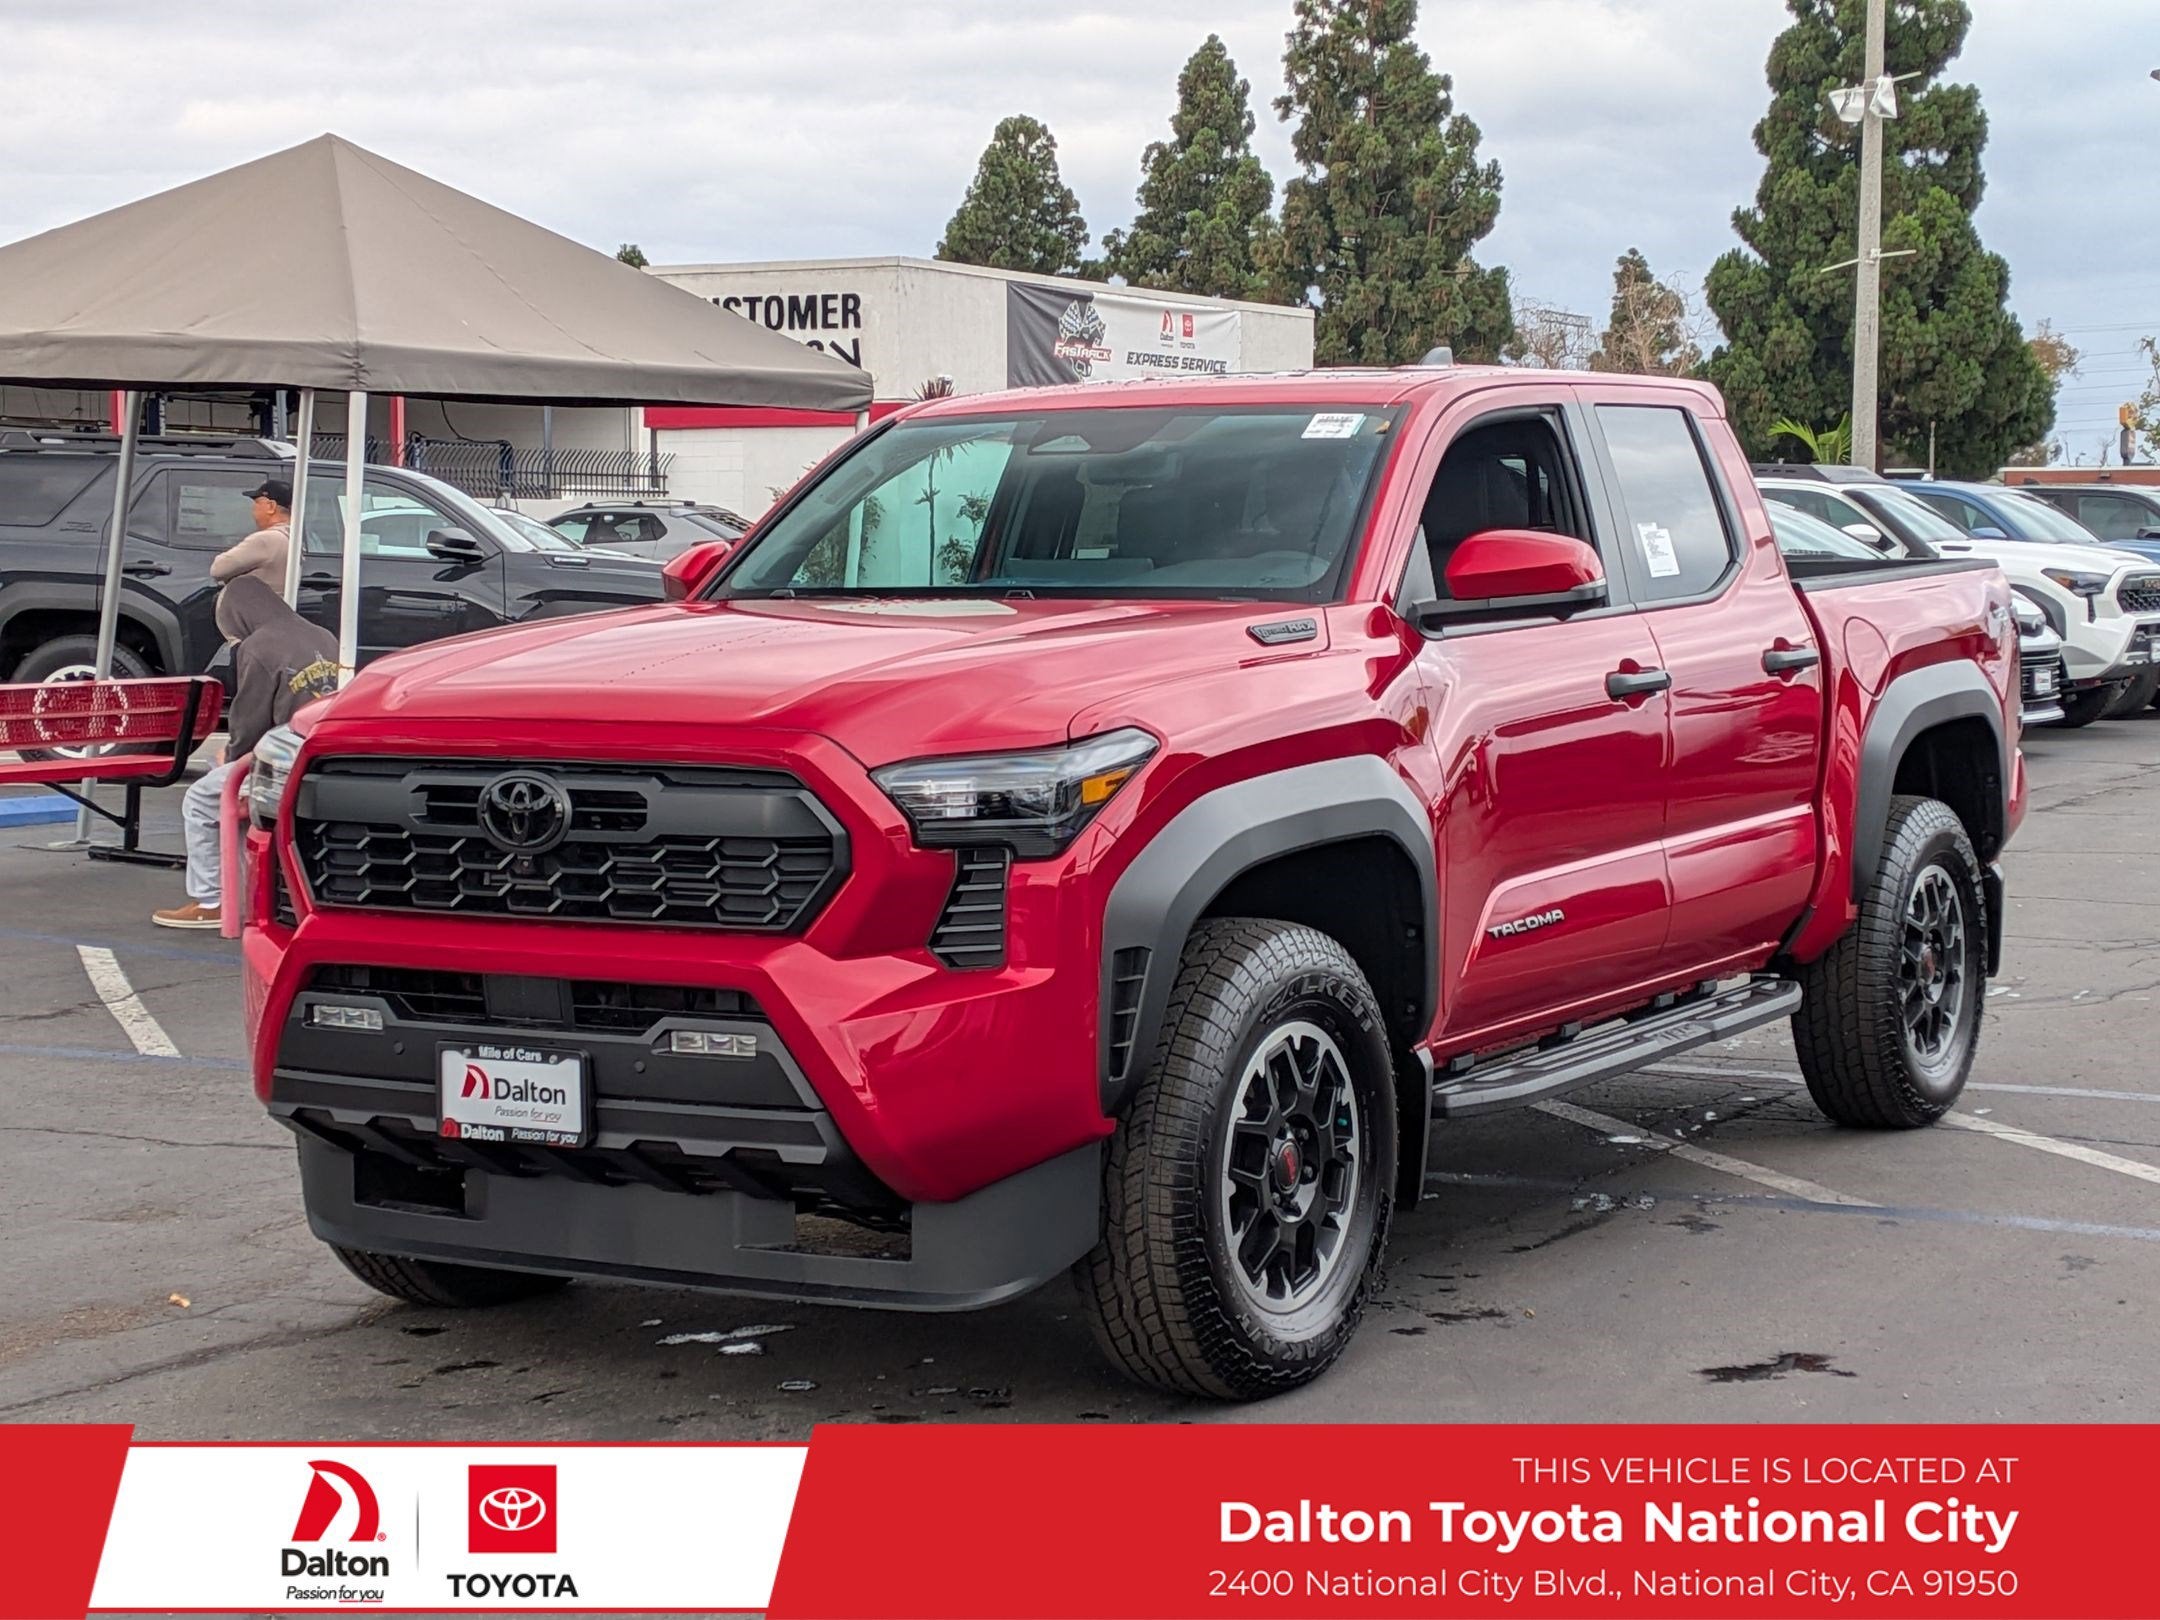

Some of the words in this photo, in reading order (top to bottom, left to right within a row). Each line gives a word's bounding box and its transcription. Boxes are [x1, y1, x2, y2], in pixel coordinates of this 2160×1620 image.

[702, 293, 862, 331] TOMER
[1126, 351, 1179, 369] EXPRESS
[1181, 356, 1227, 373] SERVICE
[1486, 908, 1565, 939] TACOMA
[478, 1046, 501, 1060] Mile
[503, 1047, 515, 1059] of
[516, 1049, 542, 1062] Cars
[494, 1078, 566, 1105] Dalton
[494, 1105, 528, 1118] Passion
[530, 1108, 543, 1120] for
[544, 1112, 561, 1121] you
[461, 1124, 504, 1141] Dalton
[511, 1128, 545, 1141] Passion
[546, 1131, 560, 1143] for
[559, 1134, 578, 1145] you
